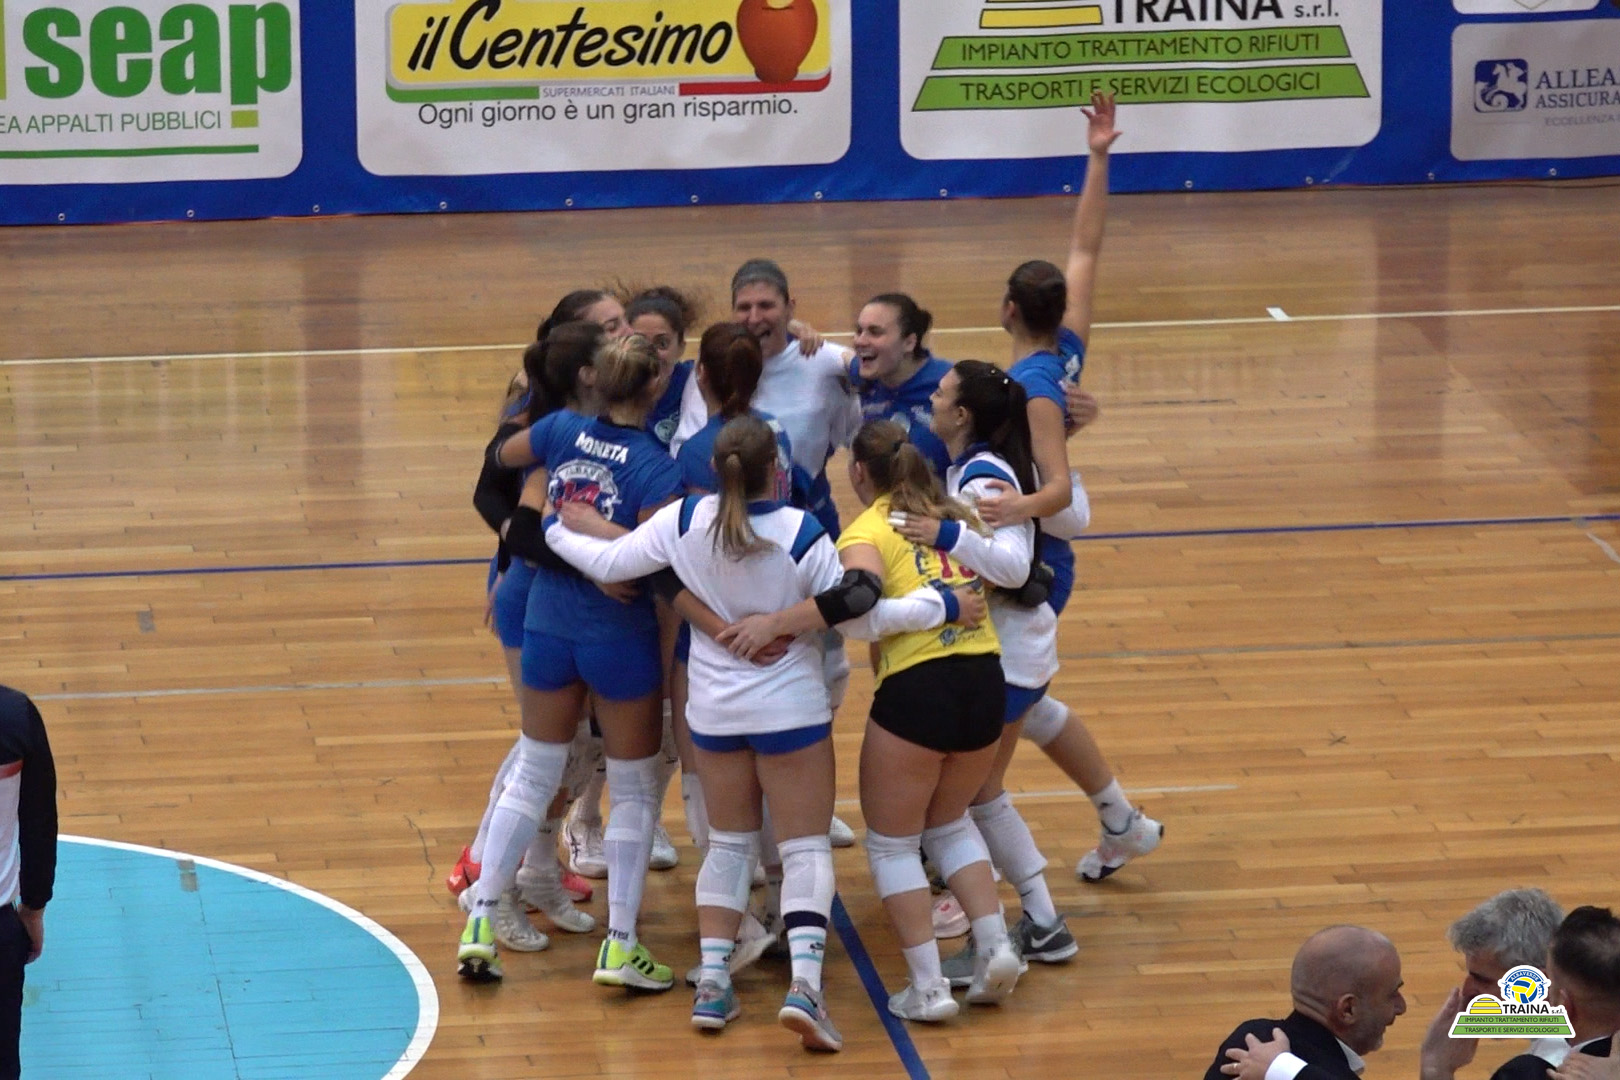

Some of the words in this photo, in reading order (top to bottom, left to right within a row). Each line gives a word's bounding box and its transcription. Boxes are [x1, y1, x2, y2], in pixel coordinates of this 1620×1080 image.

[1294, 0, 1339, 18] s.r.l.
[407, 16, 450, 72] il
[450, 0, 733, 70] Centesimo
[962, 41, 1071, 61] IMPIANTO
[1077, 36, 1242, 57] TRATTAMENTO
[1250, 33, 1319, 53] RIFIUTI
[23, 1, 292, 105] seap
[542, 85, 625, 98] SUPERMERCATI
[630, 85, 676, 97] ITALIANI
[960, 79, 1083, 101] TRASPORTI
[1109, 75, 1189, 96] SERVIZI
[1197, 72, 1320, 94] ECOLOGICI
[25, 113, 113, 133] APPALTI
[121, 110, 221, 132] PUBBLICI
[418, 102, 473, 129] Ogni
[481, 100, 556, 128] giorno
[564, 98, 578, 120] è
[586, 102, 614, 120] un
[623, 101, 675, 124] gran
[684, 94, 798, 121] risparmio.
[575, 431, 629, 464] MONETA
